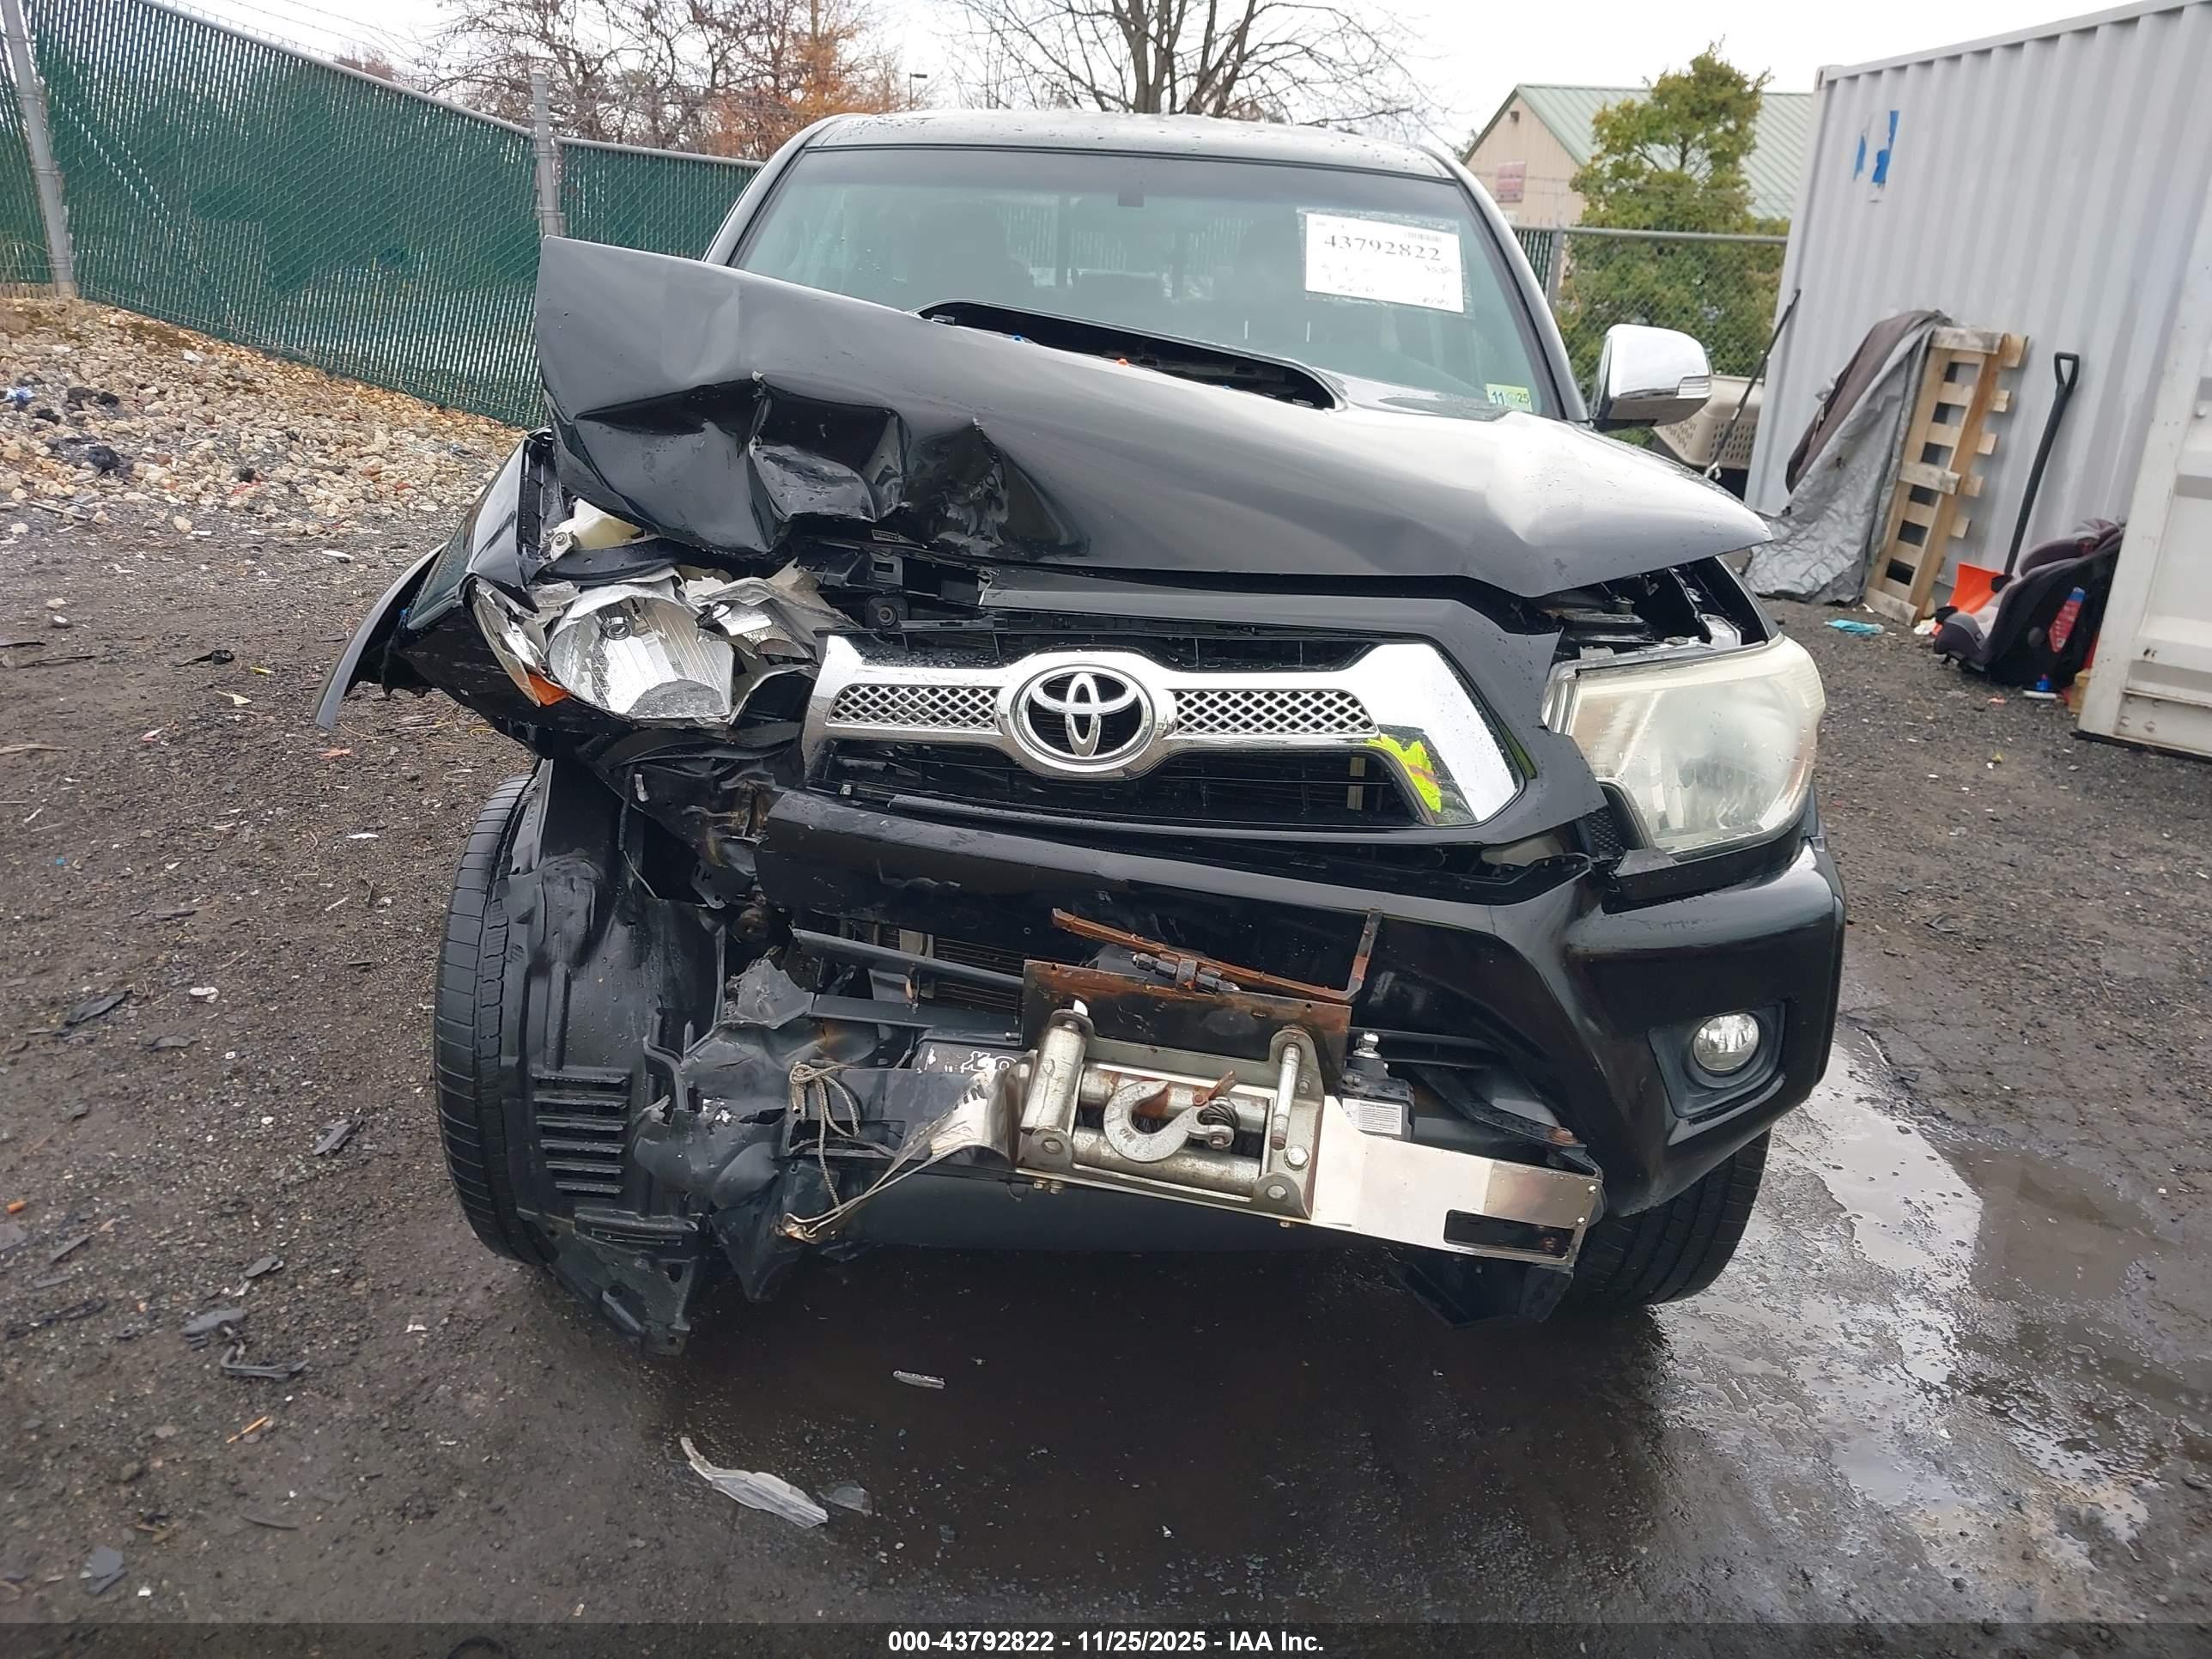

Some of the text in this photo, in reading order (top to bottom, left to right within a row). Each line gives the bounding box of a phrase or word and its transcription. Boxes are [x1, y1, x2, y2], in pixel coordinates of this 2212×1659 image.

[1323, 234, 1442, 262] 43792822
[1492, 391, 1530, 404] 11 25
